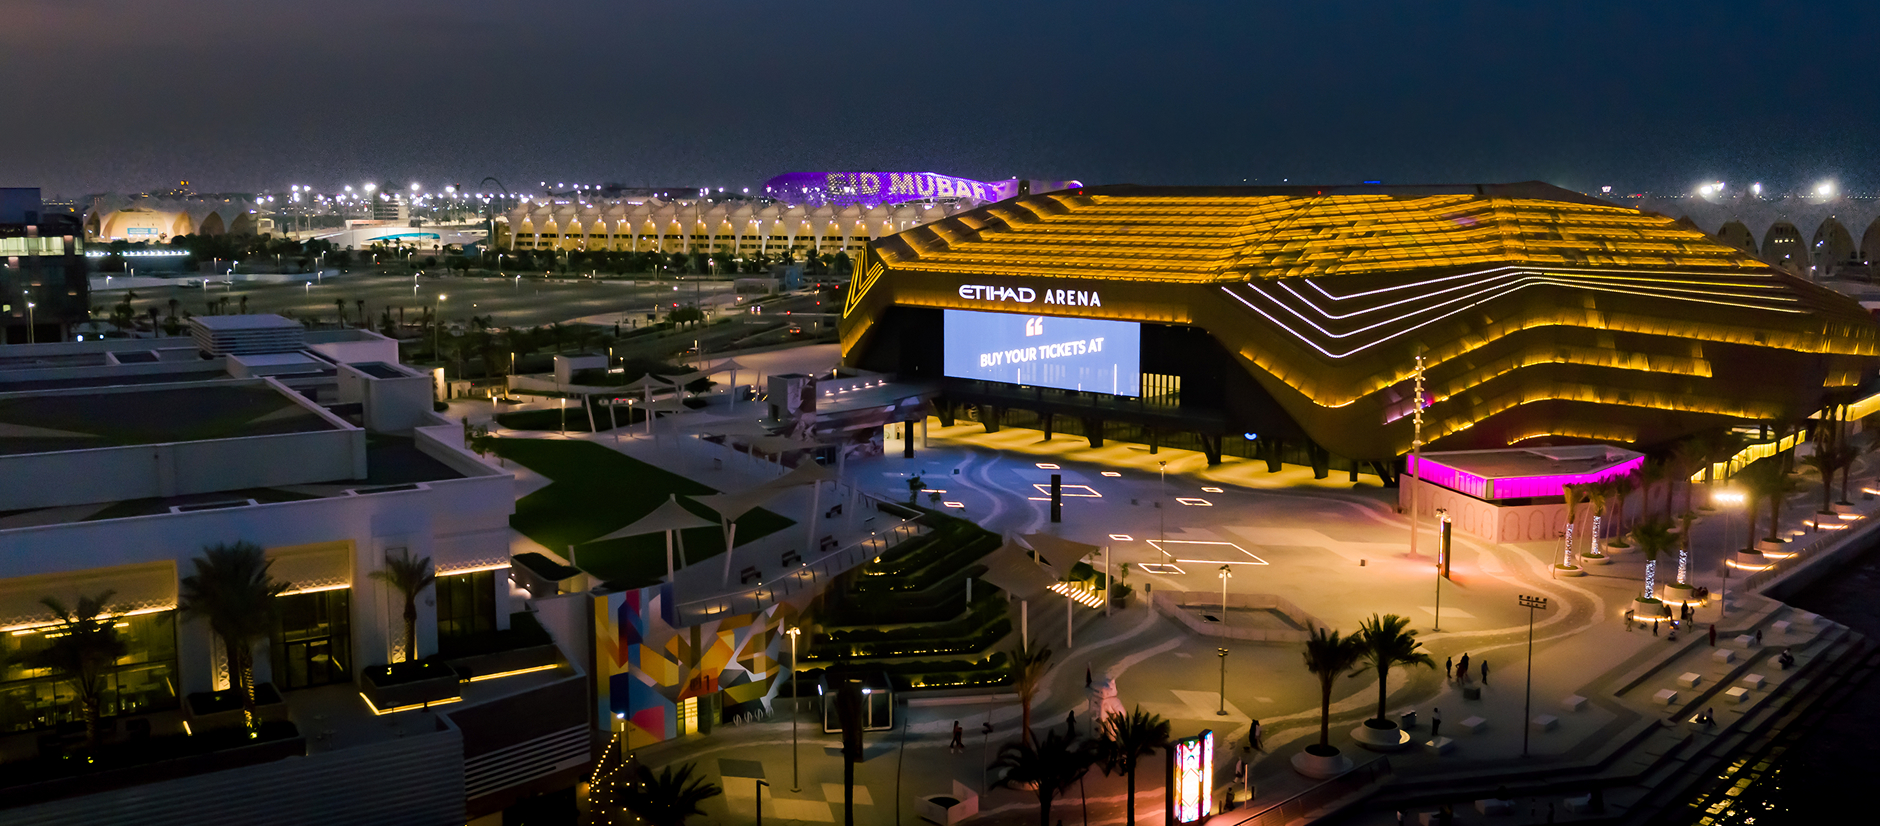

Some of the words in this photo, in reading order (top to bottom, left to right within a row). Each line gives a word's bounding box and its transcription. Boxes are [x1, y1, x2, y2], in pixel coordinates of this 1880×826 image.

[827, 173, 880, 195] EID
[959, 284, 1036, 303] ETIHAD
[1044, 288, 1101, 307] ARENA
[980, 351, 1003, 367] BUY
[1005, 347, 1037, 364] YOUR
[1039, 339, 1086, 359] TICKETS
[1088, 337, 1104, 353] AT
